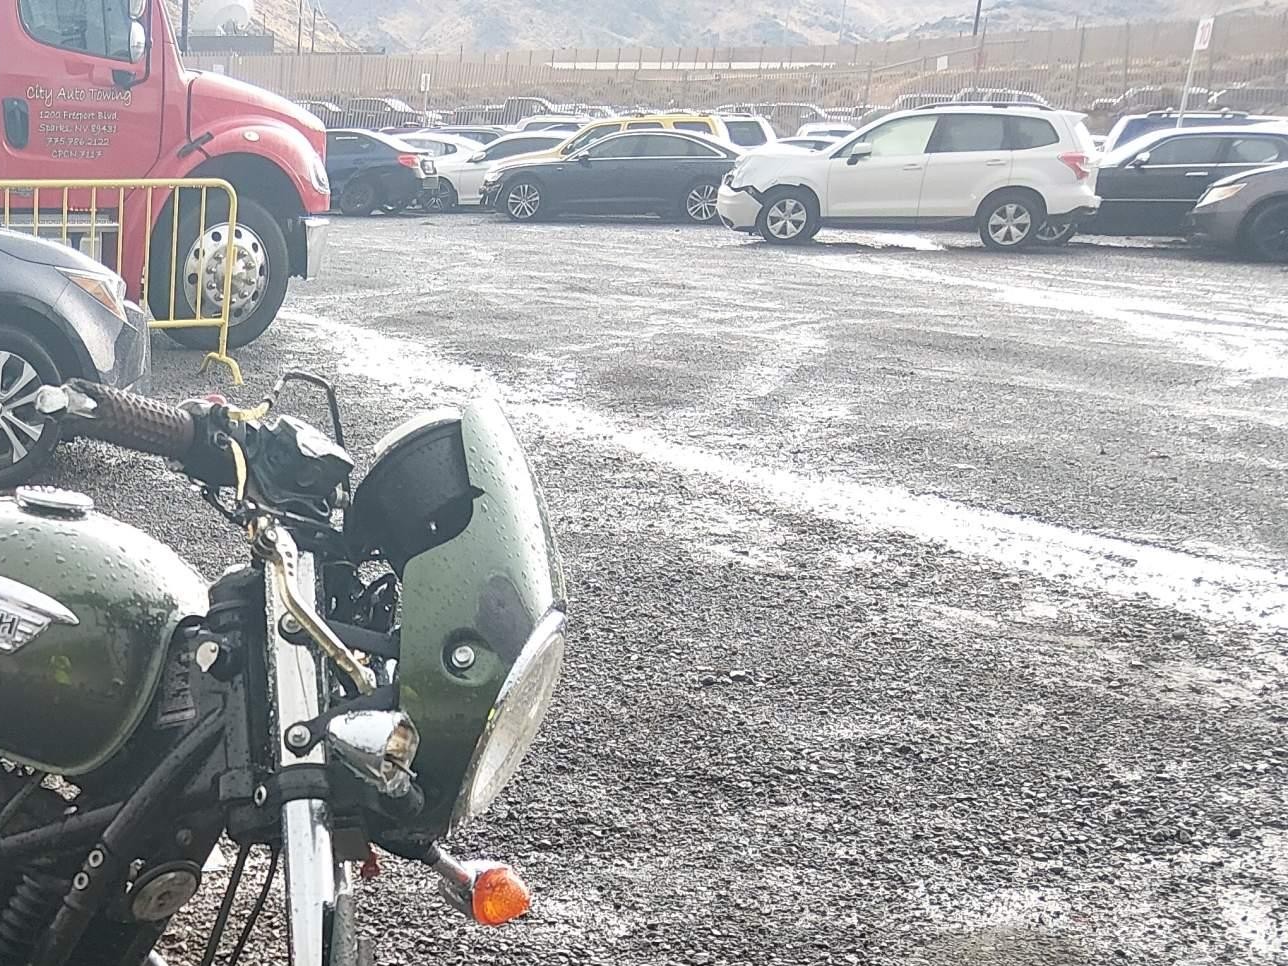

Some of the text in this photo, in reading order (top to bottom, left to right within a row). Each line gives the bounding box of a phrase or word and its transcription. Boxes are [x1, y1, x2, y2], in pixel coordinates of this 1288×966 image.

[26, 83, 133, 108] City Auto Towing
[63, 111, 96, 122] Freeport
